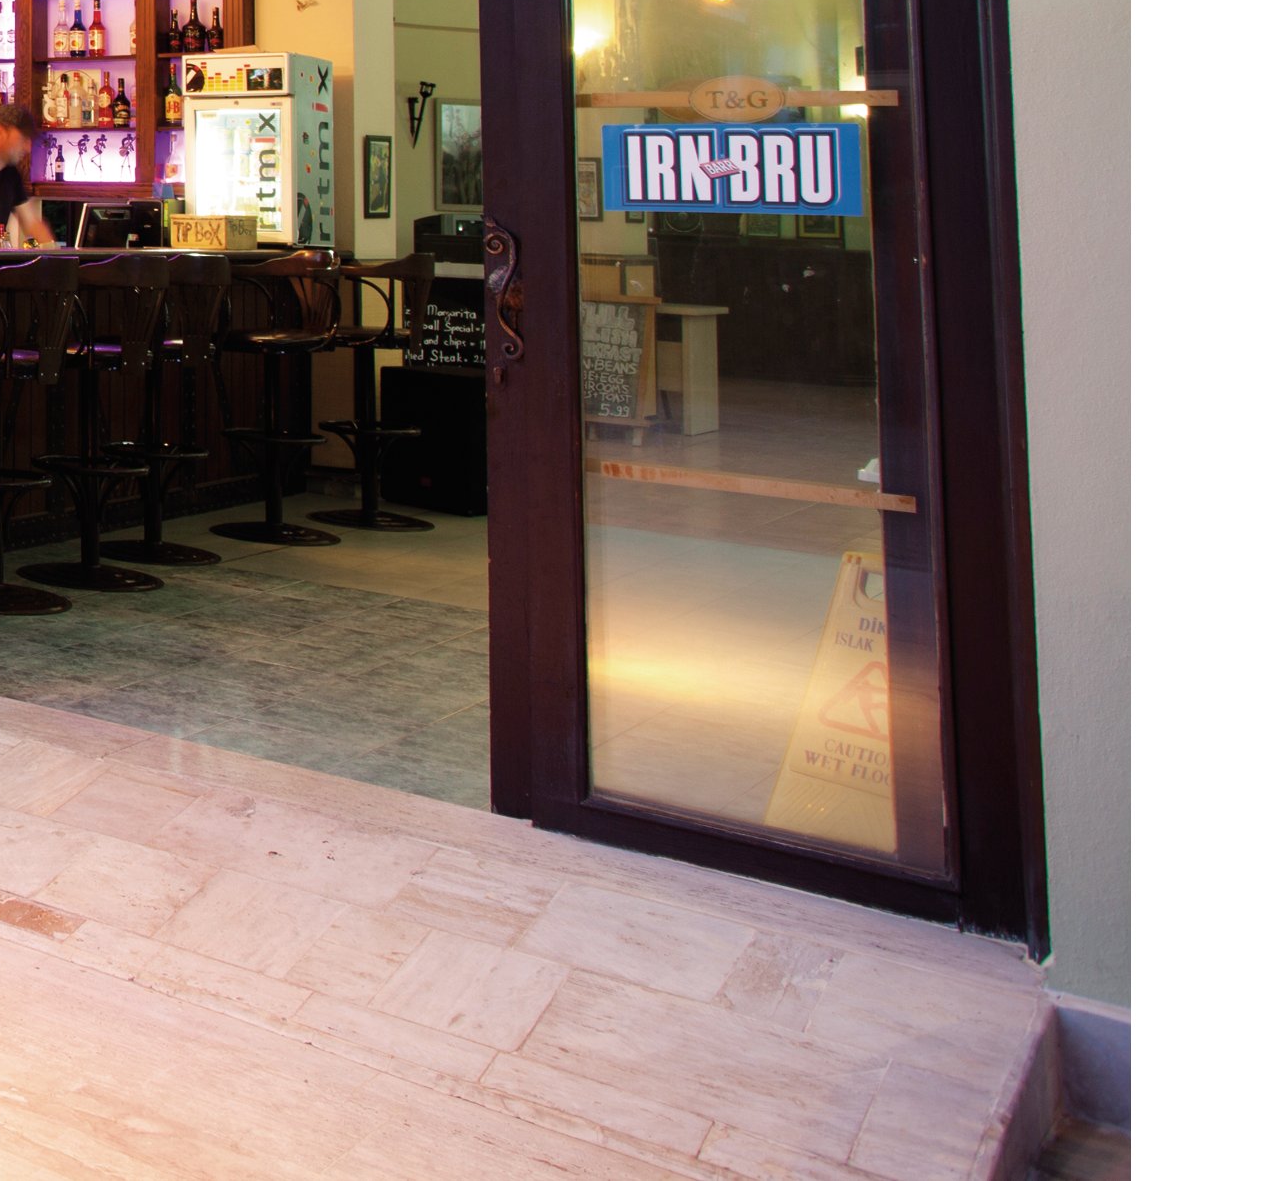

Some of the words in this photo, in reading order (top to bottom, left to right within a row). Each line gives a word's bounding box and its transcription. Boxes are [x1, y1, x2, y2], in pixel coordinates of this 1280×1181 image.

[705, 90, 769, 110] T&G
[705, 159, 738, 176] BARR
[427, 304, 477, 323] Margarita
[430, 349, 462, 363] Steak
[835, 631, 875, 653] ISLAK
[804, 749, 846, 772] WET
